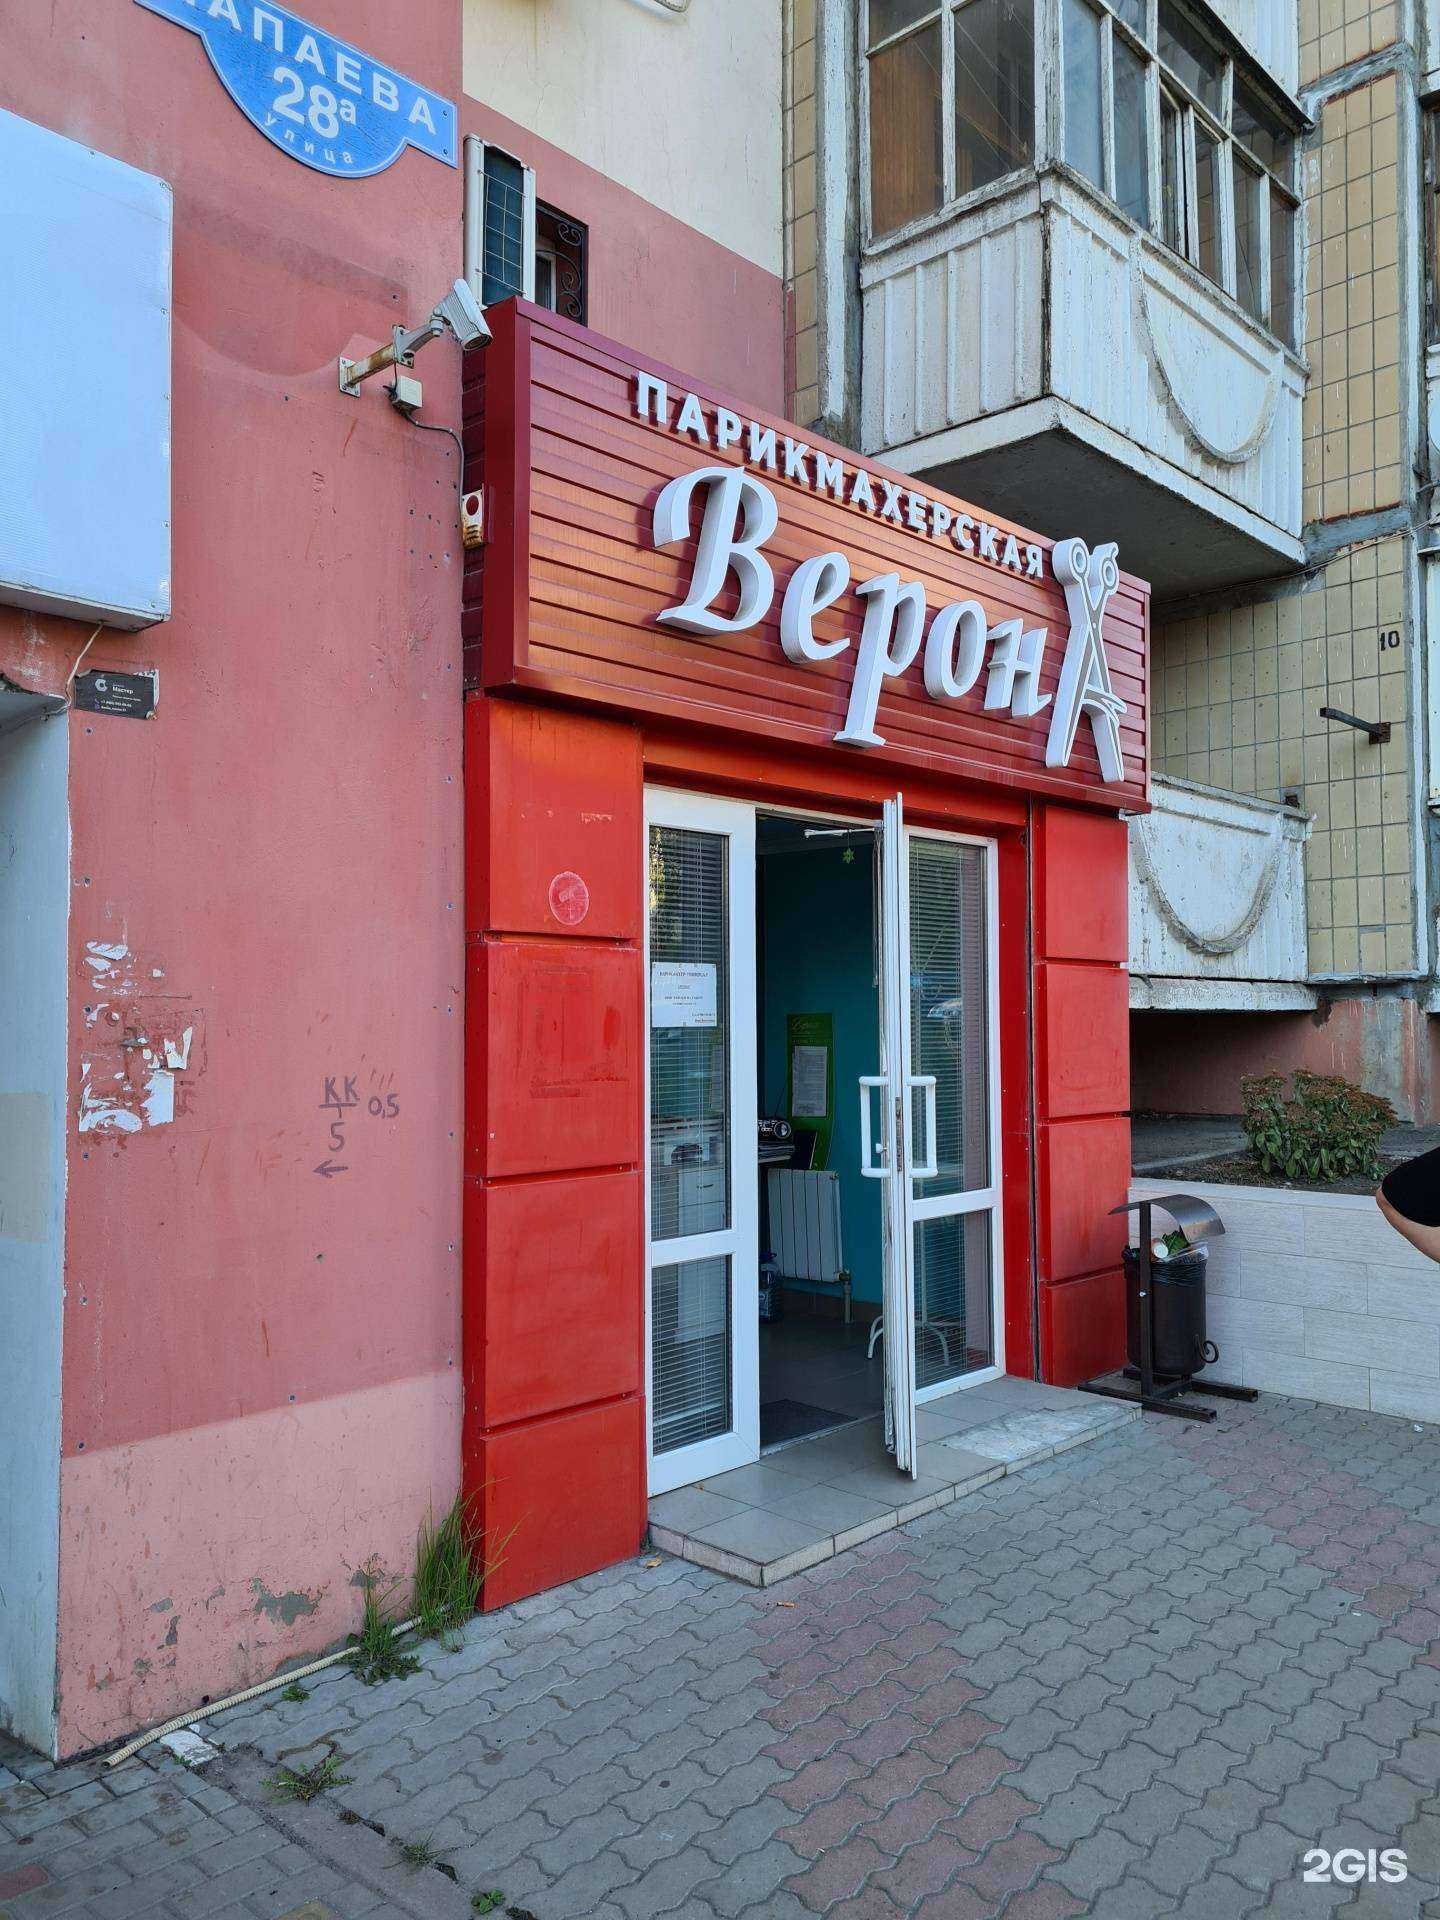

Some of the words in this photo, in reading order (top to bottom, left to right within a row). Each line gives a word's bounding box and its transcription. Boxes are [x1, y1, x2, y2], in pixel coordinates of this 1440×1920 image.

[184, 0, 437, 136] АПАЕВА
[272, 66, 357, 139] 28а
[263, 111, 354, 165] улица
[636, 370, 1044, 580] ПАРИКМАХЕРСКАЯ
[1379, 630, 1401, 652] 10
